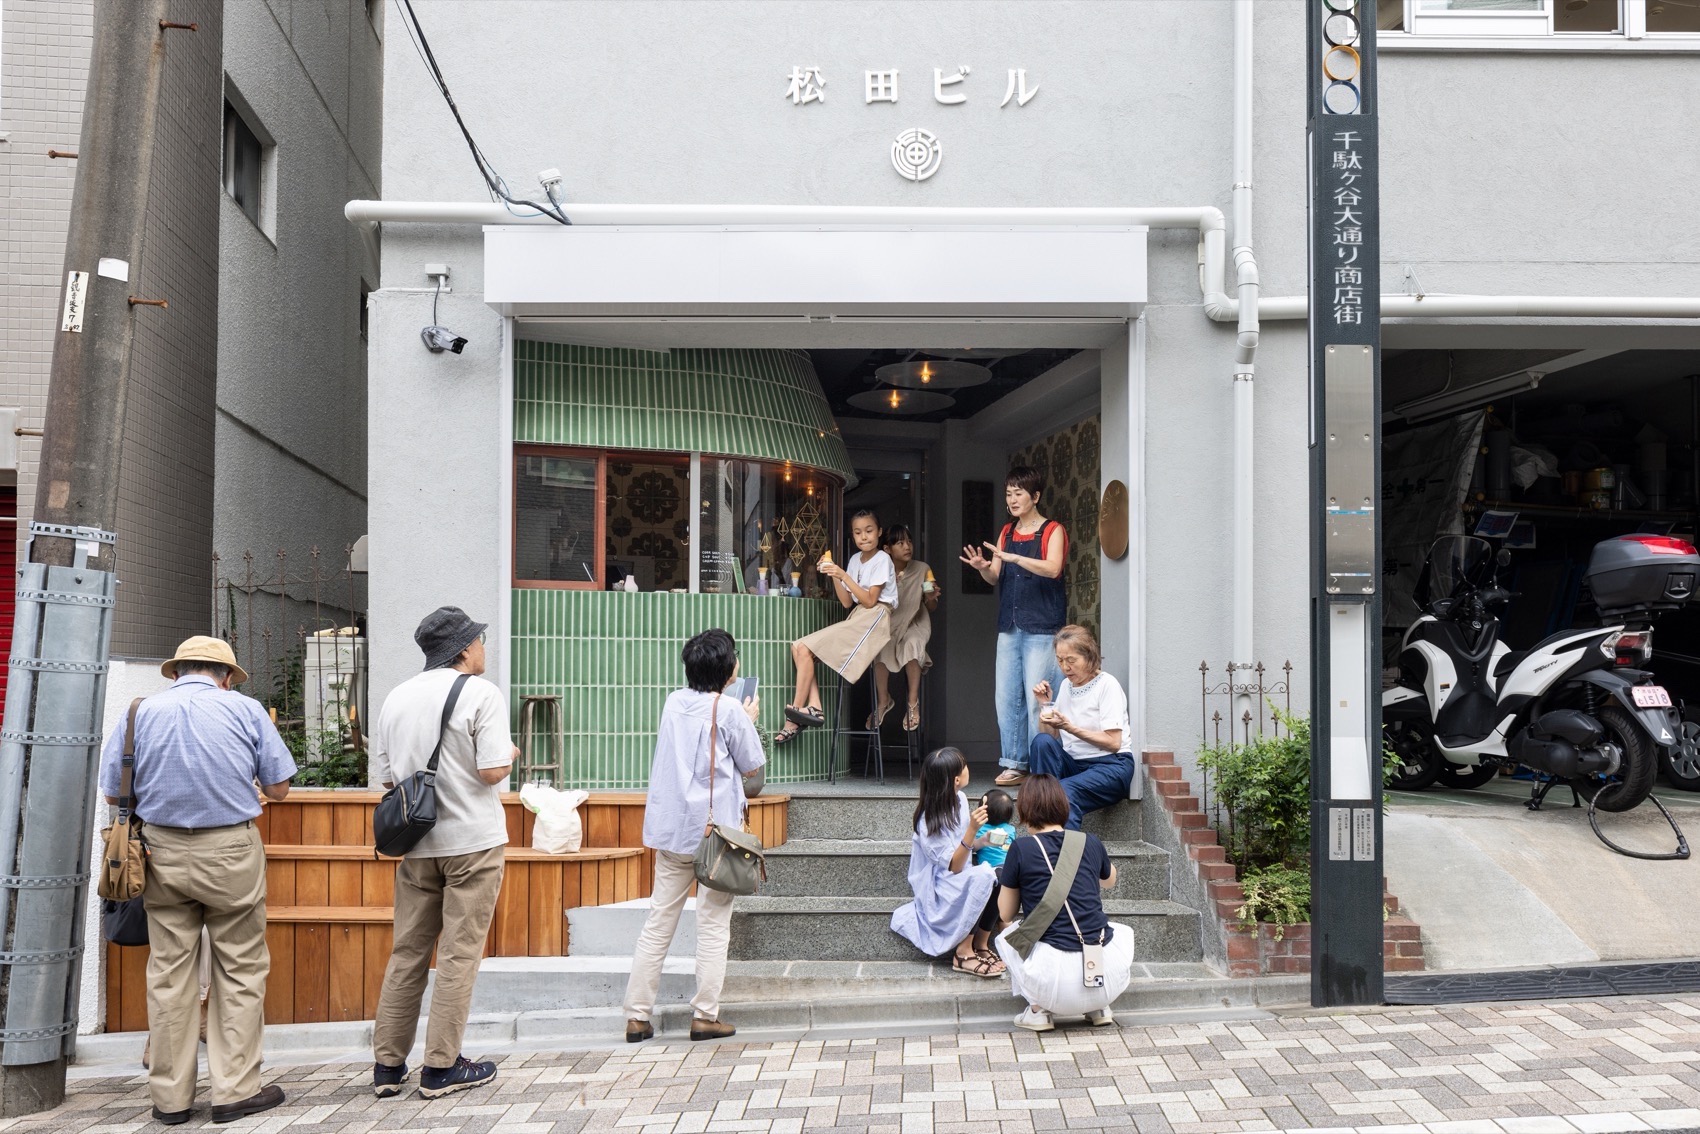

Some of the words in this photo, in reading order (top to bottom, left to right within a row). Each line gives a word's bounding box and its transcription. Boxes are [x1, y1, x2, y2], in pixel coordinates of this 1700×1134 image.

[785, 64, 1040, 108] 松田ビル
[1644, 693, 1668, 705] 1518
